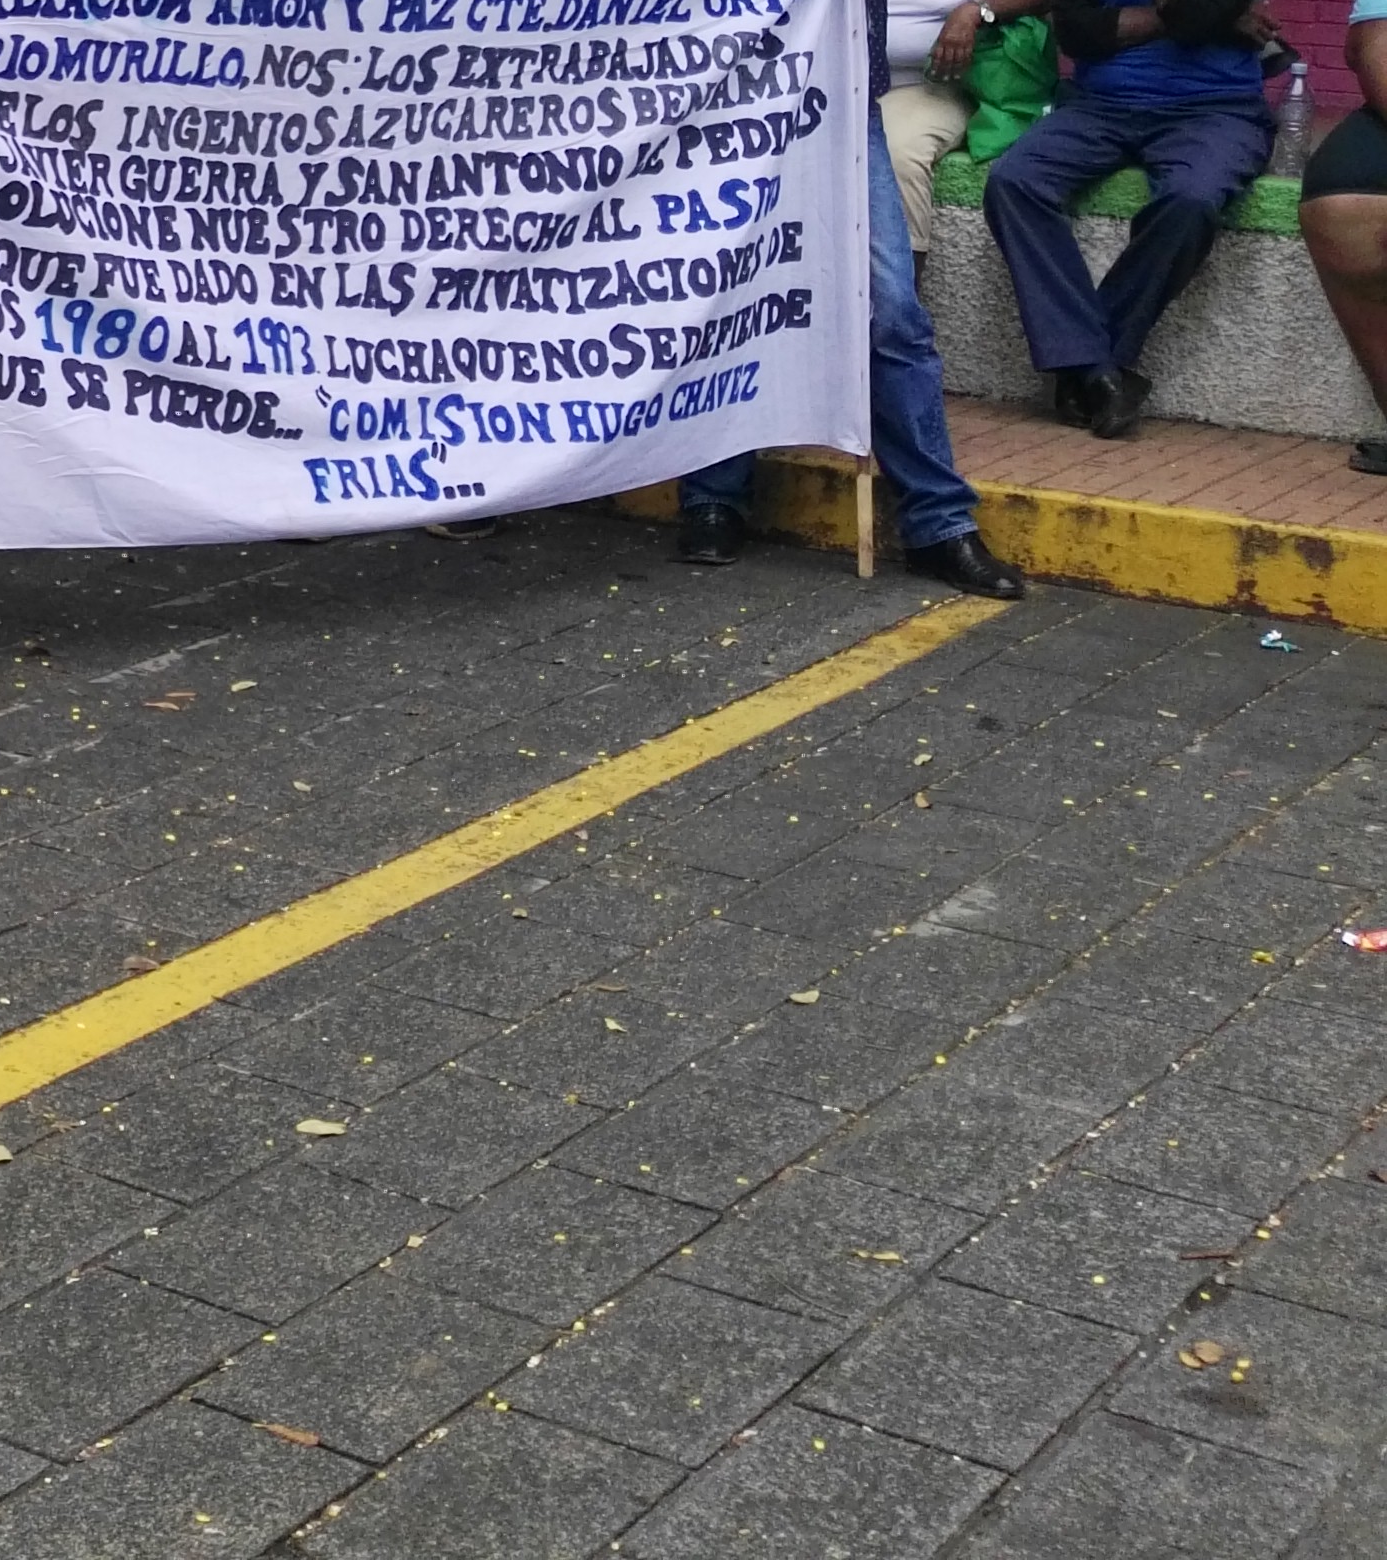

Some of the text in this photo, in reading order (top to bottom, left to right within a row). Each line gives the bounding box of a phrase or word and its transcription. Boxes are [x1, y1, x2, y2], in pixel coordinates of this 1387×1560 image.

[359, 44, 449, 95] LOS
[449, 28, 785, 91] EXTRABAJADOR
[117, 106, 338, 157] INGENIOS
[338, 86, 627, 150] AZUCAREROS
[120, 155, 283, 207] GUERRA
[299, 163, 329, 208] Y
[324, 157, 422, 207] SAN
[426, 145, 623, 202] ANTONIO
[676, 87, 827, 169] PEDIS
[189, 203, 385, 259] NUESTRO
[400, 207, 580, 253] DERECHO
[583, 198, 641, 242] AL
[89, 253, 166, 302] FUE
[167, 259, 257, 305] DADO
[269, 262, 326, 309] EN
[335, 262, 416, 317] LAS
[425, 234, 764, 318] PRIVATIZACIONES
[766, 221, 803, 268] DE
[35, 298, 169, 362] 1980
[173, 321, 231, 371] AL
[61, 358, 110, 411] SE
[561, 392, 663, 444] HUGO
[669, 361, 759, 421] CHAVEZ
